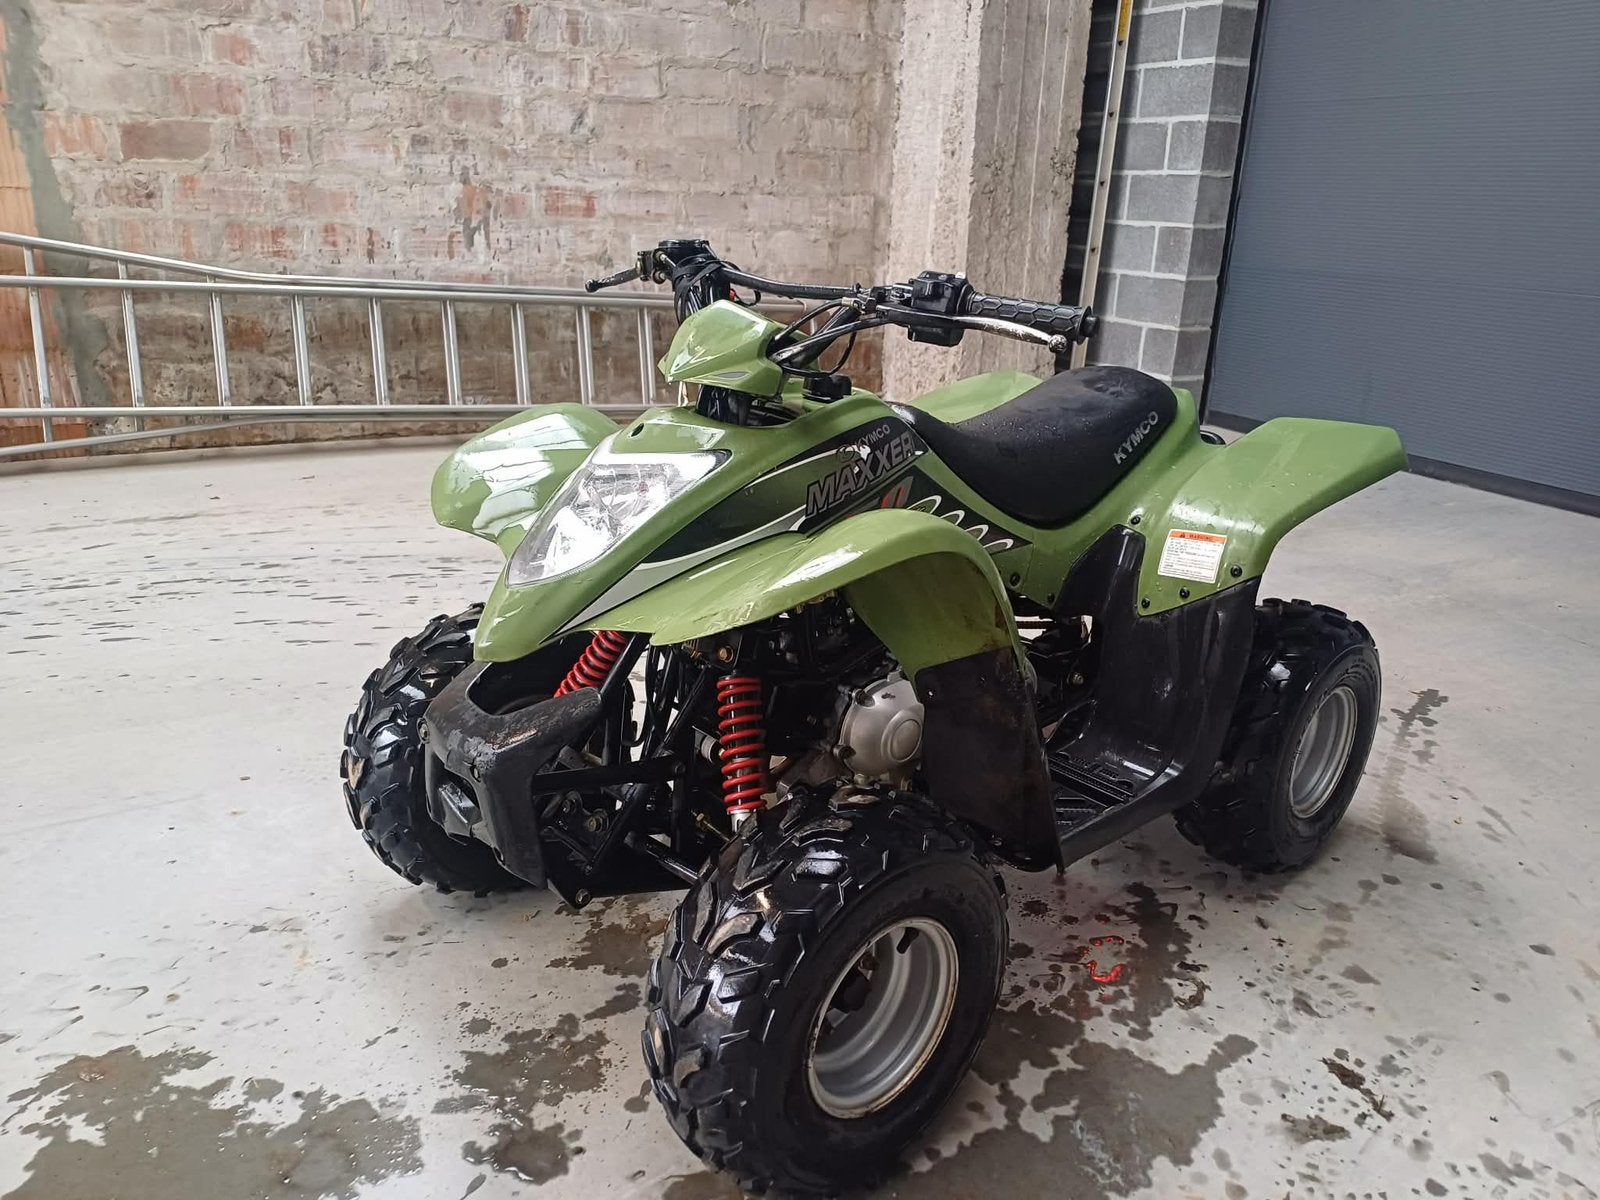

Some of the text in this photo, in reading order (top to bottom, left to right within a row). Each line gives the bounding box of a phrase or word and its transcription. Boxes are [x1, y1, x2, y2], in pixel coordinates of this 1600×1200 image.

[855, 424, 891, 449] KYMCO
[1113, 411, 1158, 464] KYMCO
[807, 431, 916, 515] MAXXER
